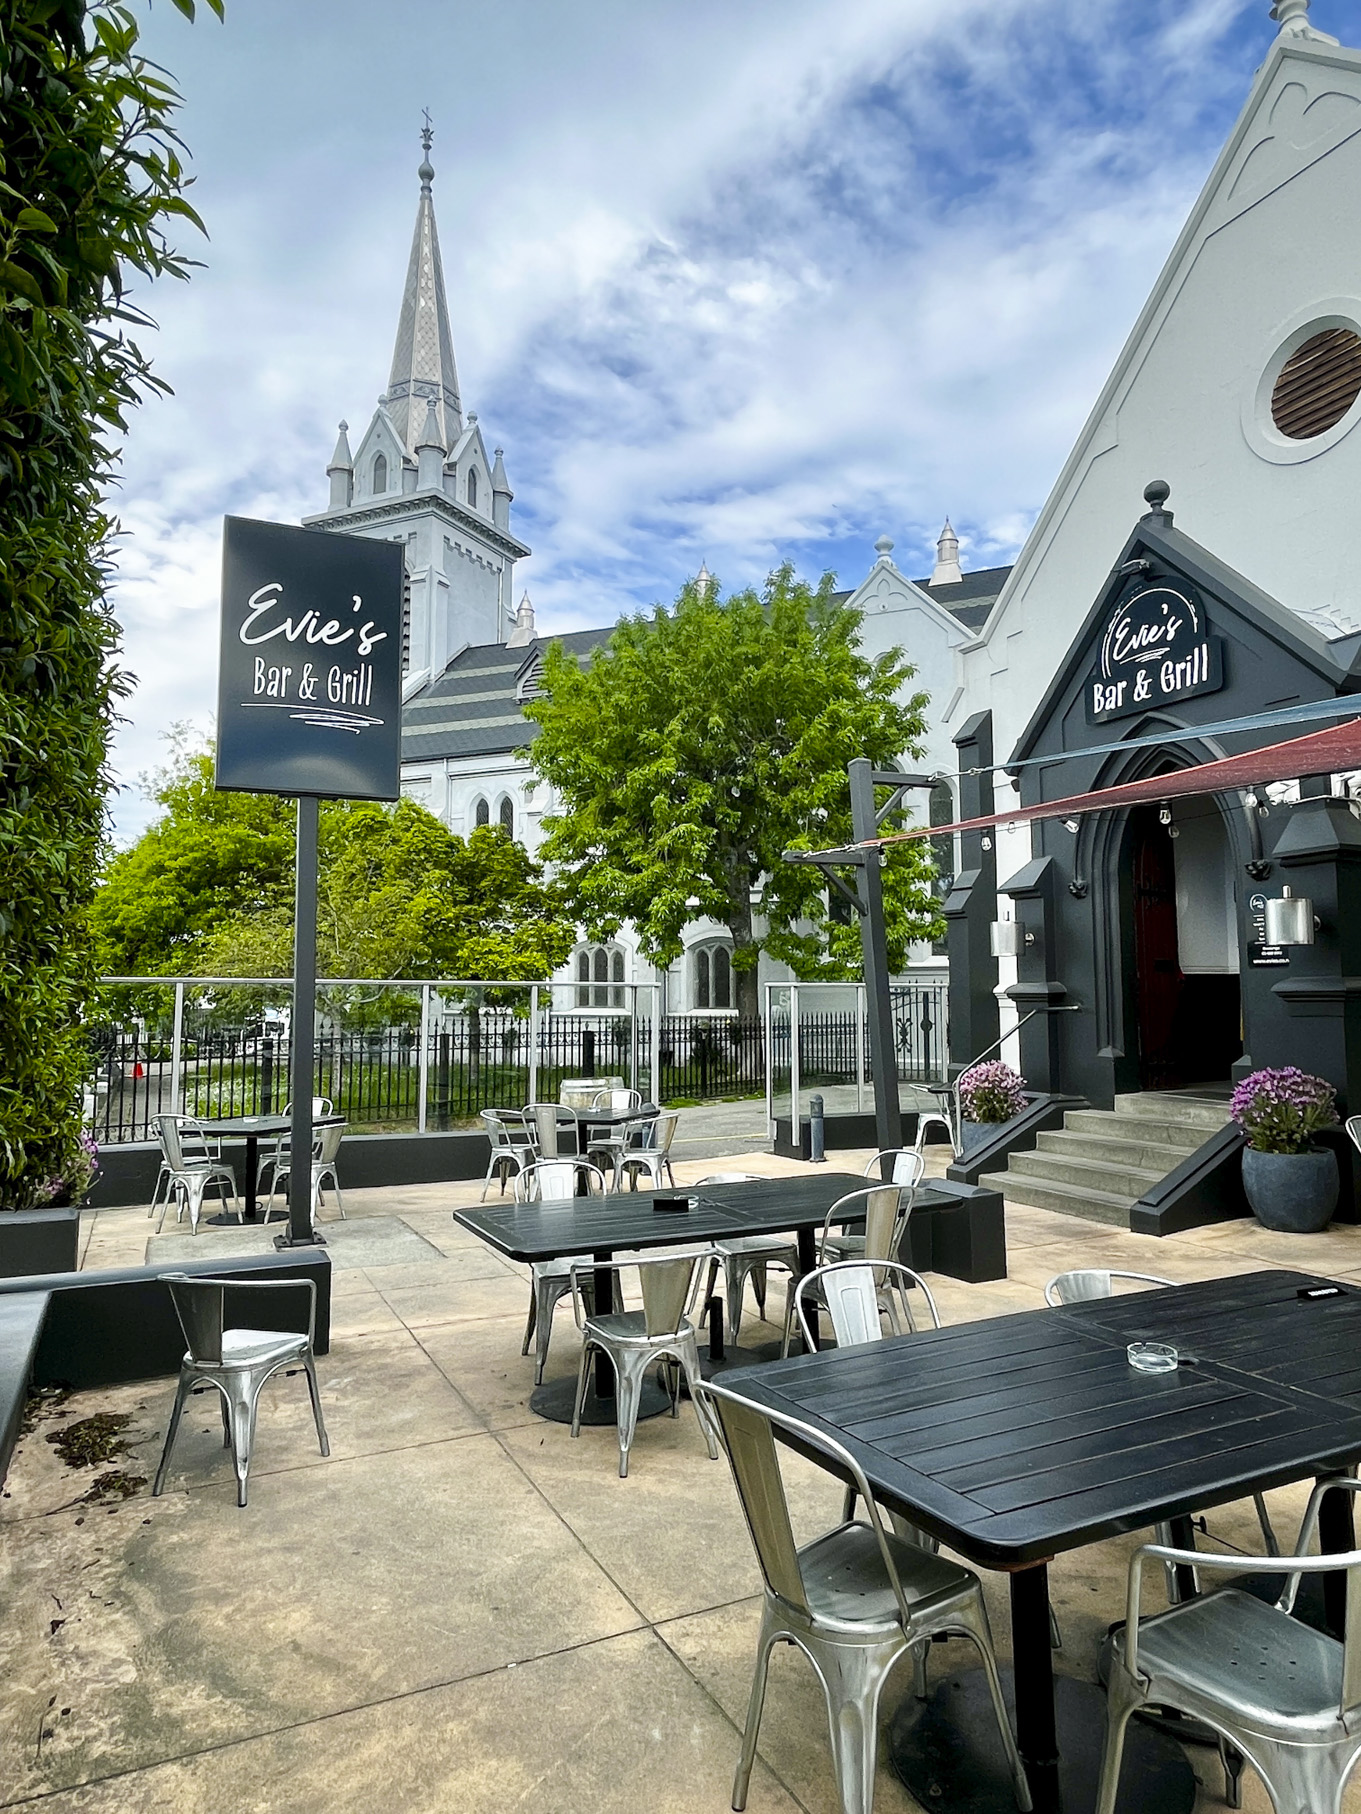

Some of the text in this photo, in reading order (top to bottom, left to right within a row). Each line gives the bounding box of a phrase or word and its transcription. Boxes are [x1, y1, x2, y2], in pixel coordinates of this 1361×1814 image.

[238, 582, 388, 656] Evie's
[1112, 603, 1183, 661] Evie's
[253, 656, 374, 706] Bar & Grill
[1093, 643, 1208, 714] Bar & Grill
